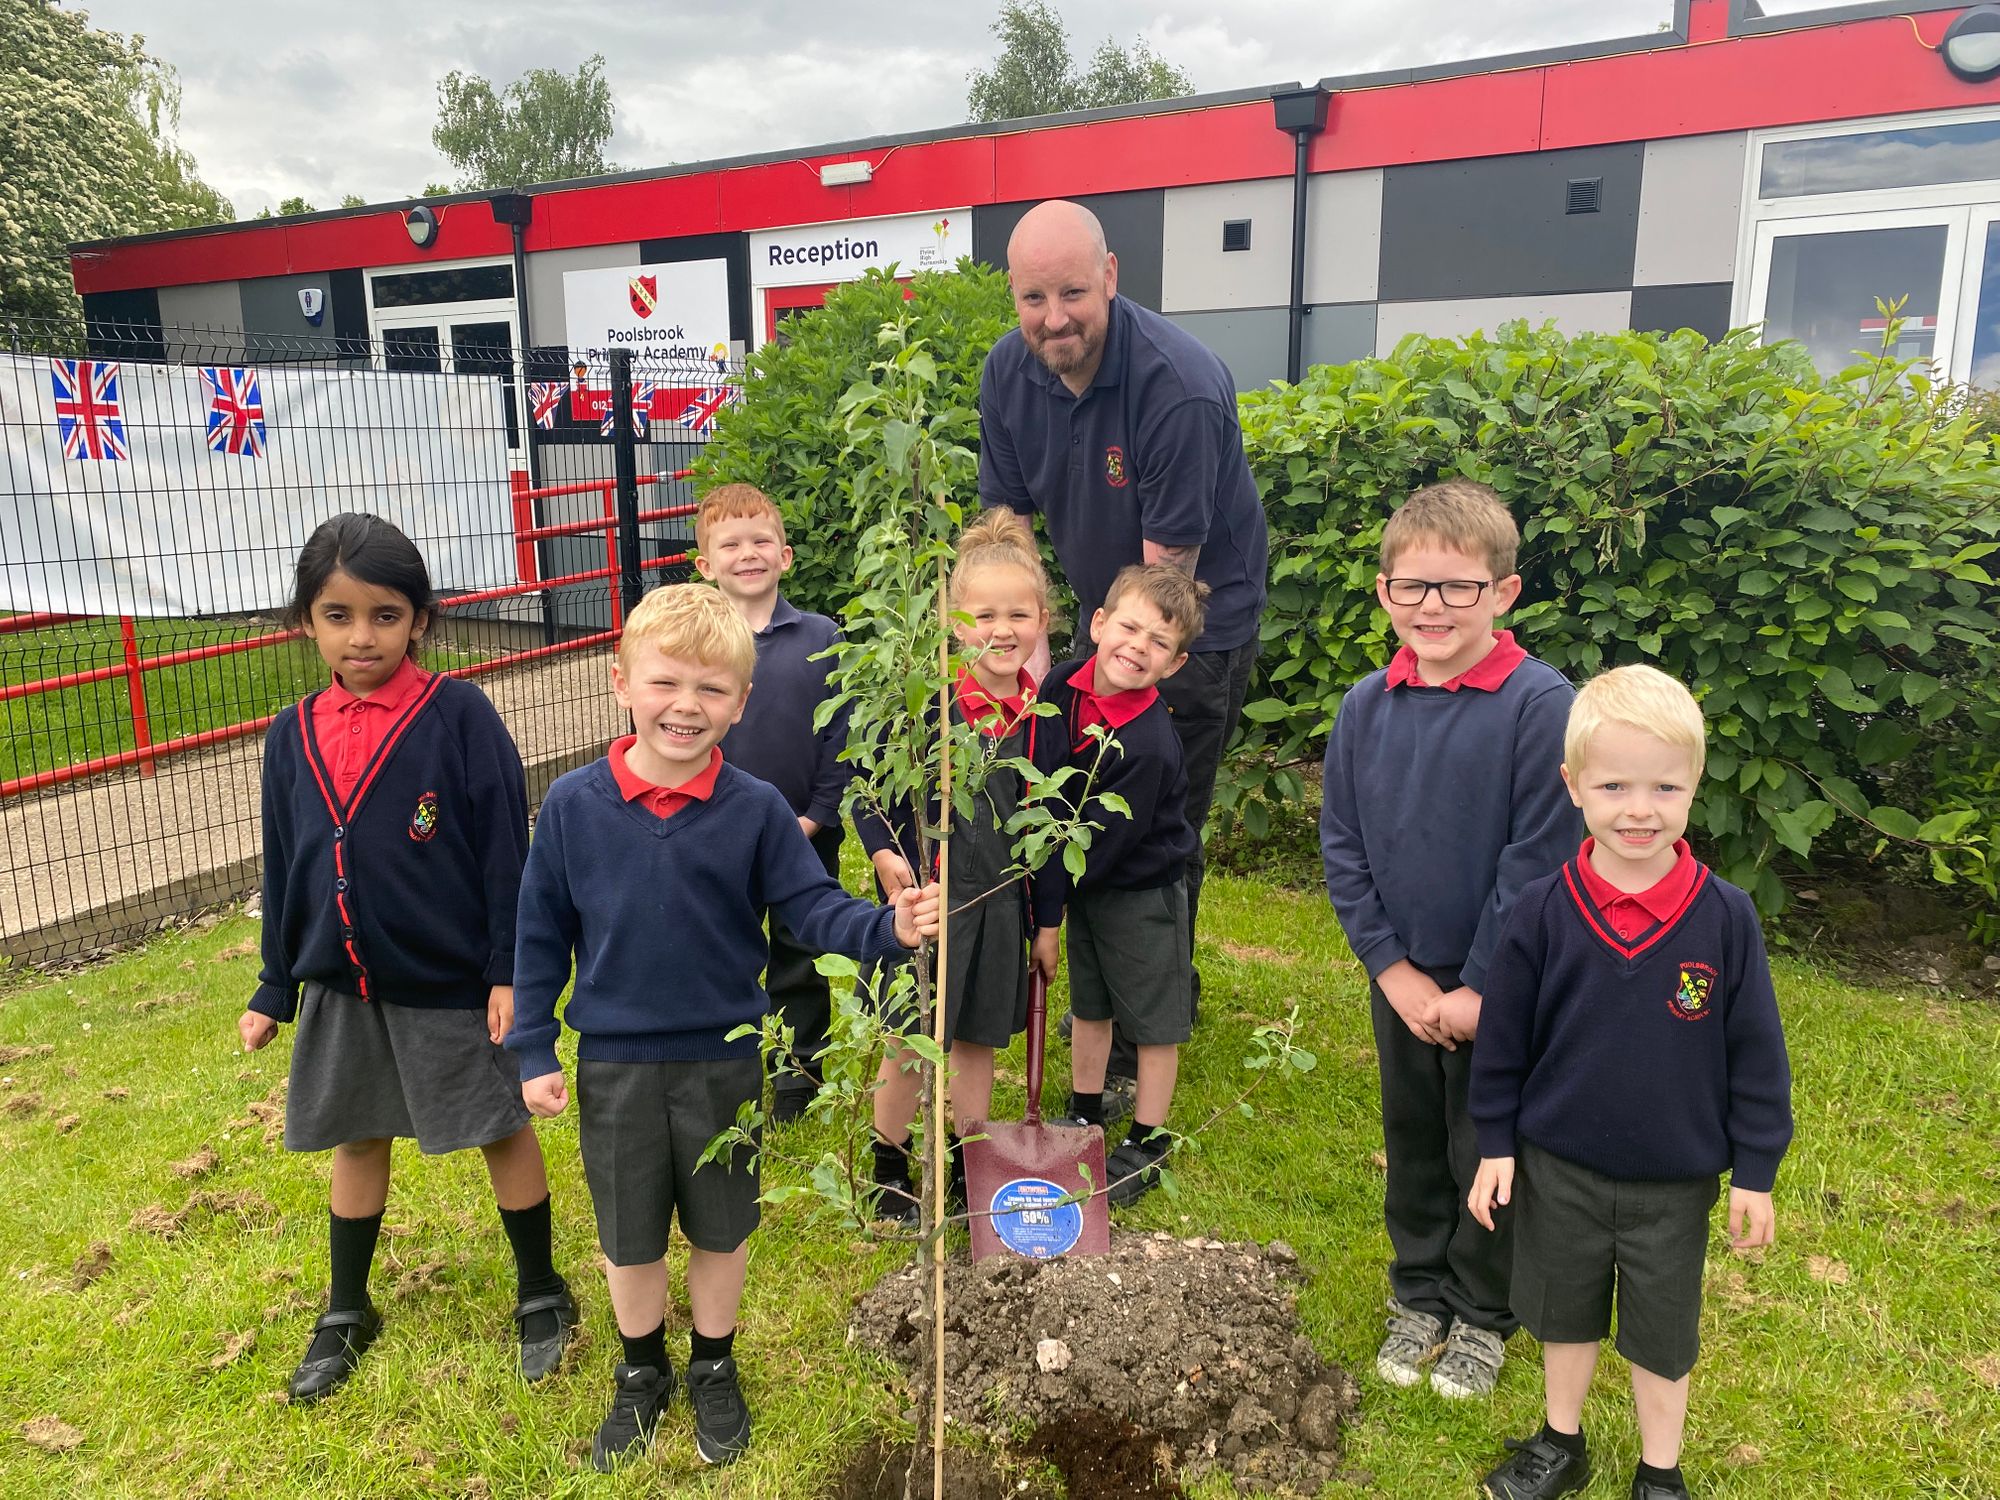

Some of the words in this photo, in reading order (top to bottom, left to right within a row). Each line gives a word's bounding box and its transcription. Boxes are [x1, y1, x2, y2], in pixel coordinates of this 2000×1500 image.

[769, 237, 878, 266] Reception
[607, 325, 684, 343] Poolsbrook
[644, 344, 707, 361] Academy
[1022, 1210, 1050, 1224] 50%
